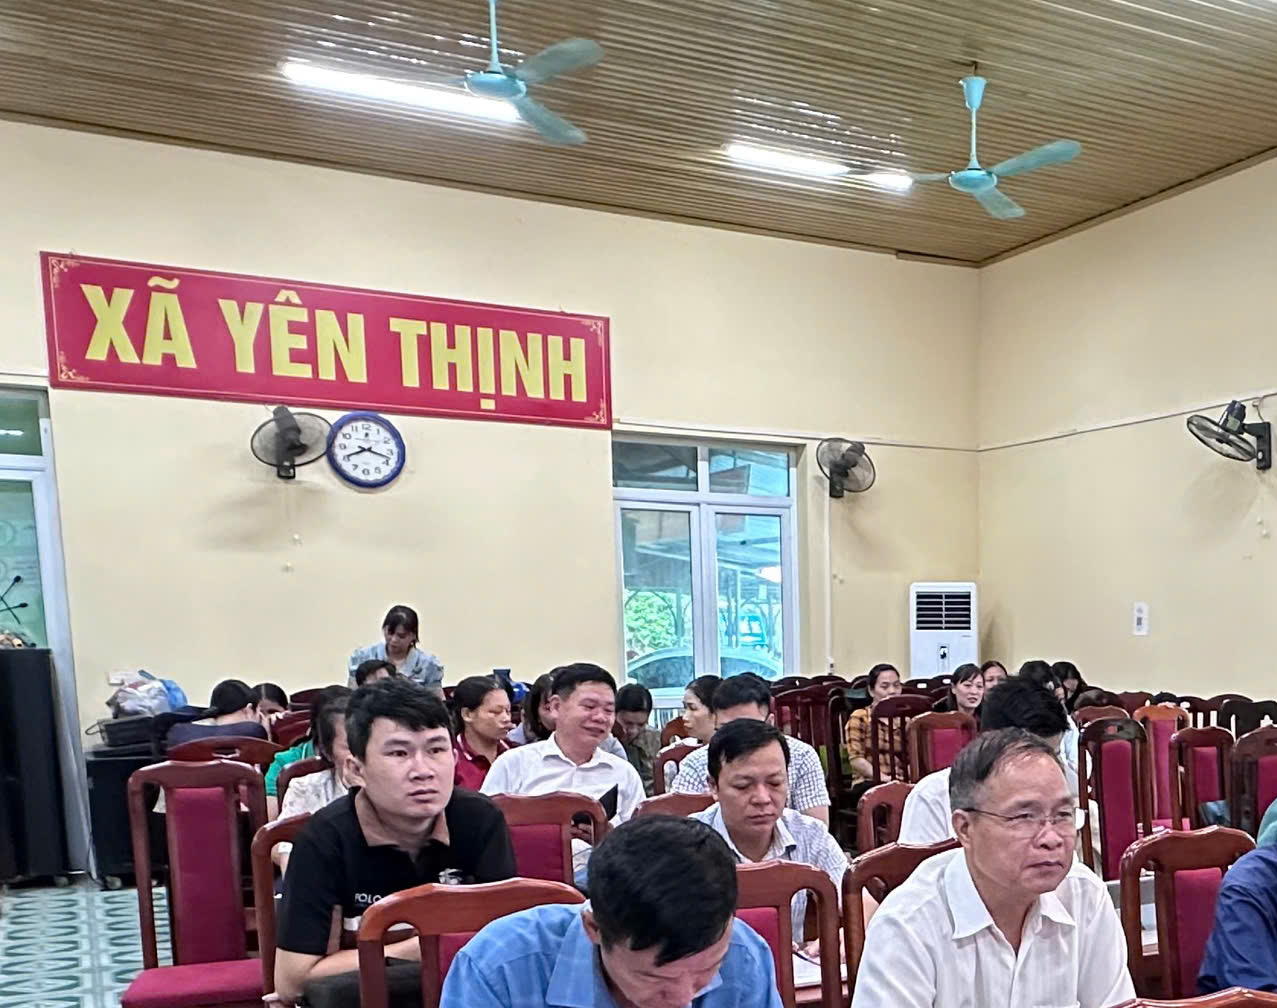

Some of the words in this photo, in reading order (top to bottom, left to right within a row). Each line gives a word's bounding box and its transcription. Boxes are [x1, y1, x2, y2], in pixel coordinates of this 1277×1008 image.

[80, 277, 197, 369] XÃ
[217, 289, 367, 383] YÊN
[389, 318, 587, 411] THỊNH
